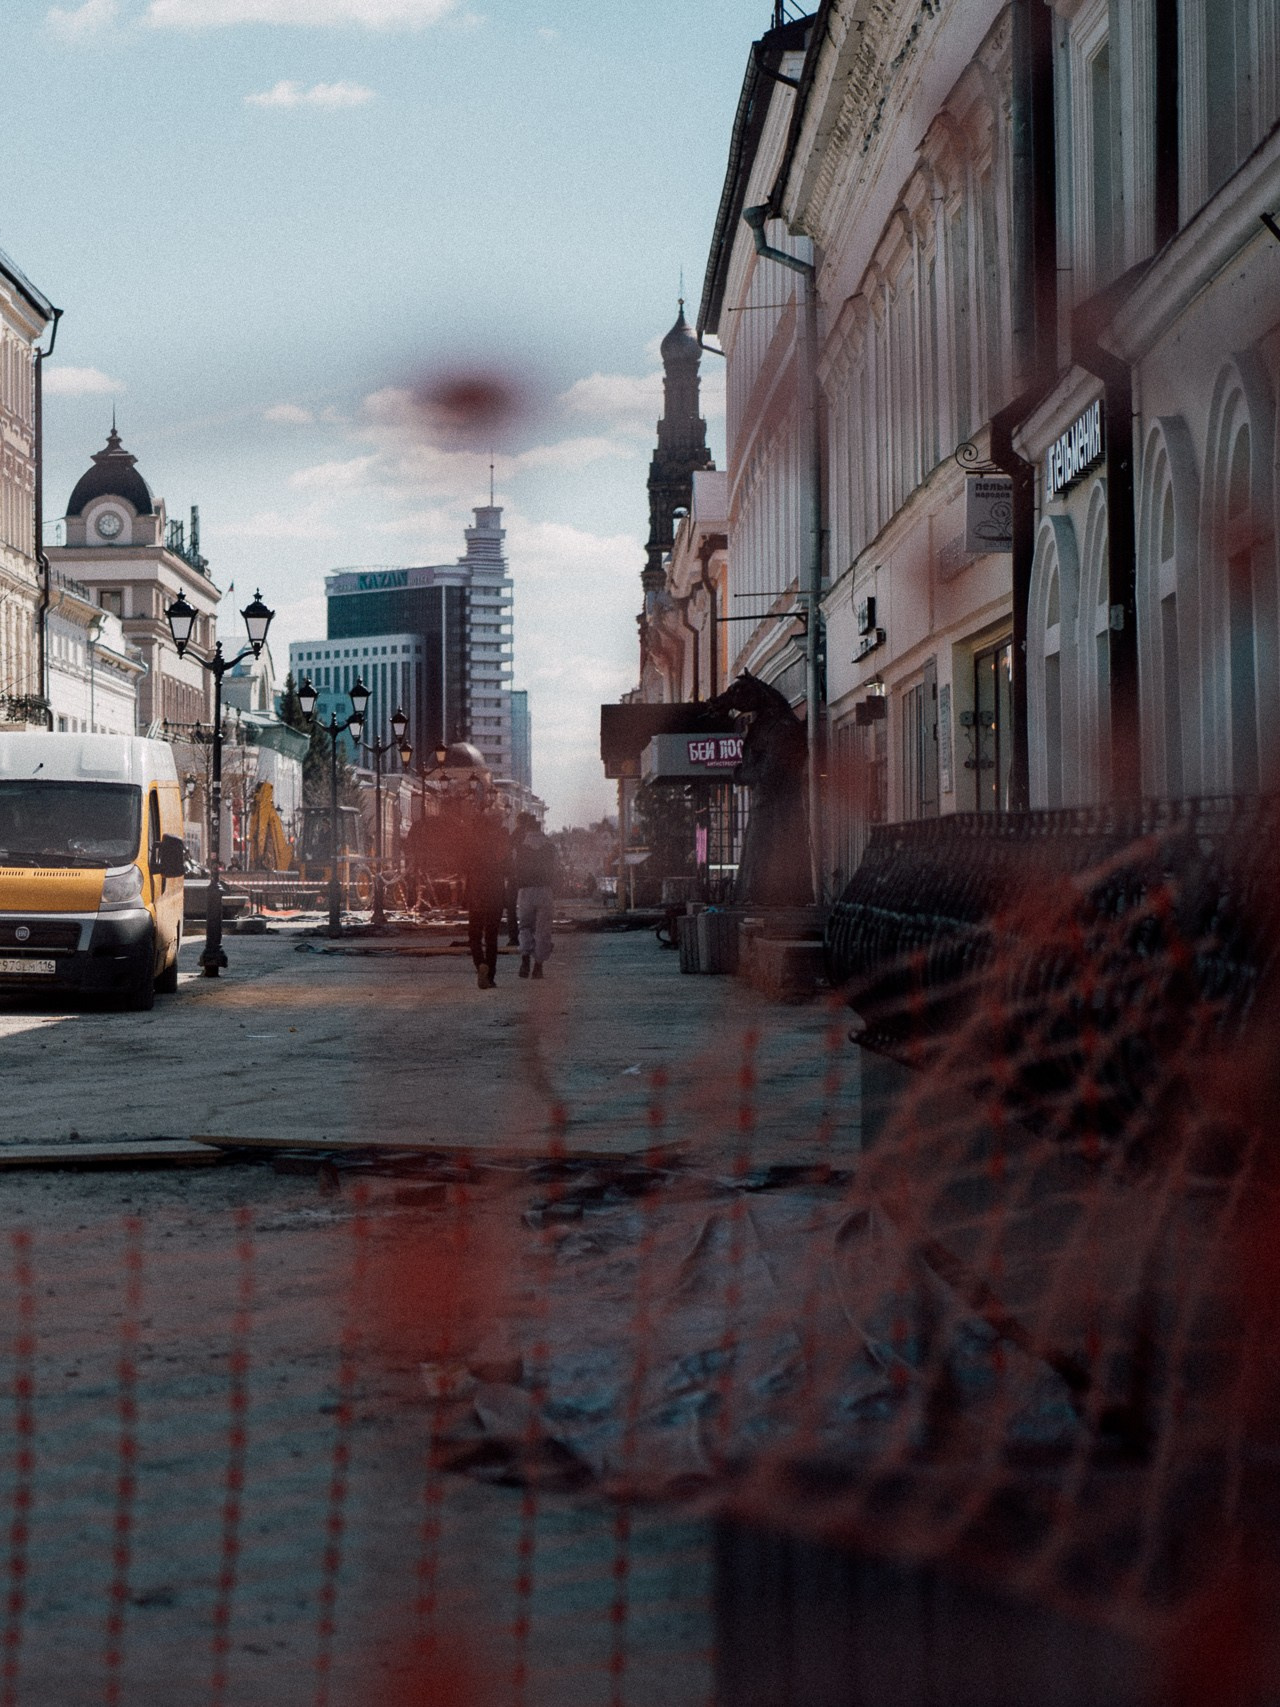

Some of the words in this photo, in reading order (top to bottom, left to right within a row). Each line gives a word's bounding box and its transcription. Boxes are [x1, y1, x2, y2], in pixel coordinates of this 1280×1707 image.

[358, 571, 407, 590] KAZAN
[689, 739, 716, 761] БЕЙ
[719, 739, 744, 759] ПОС
